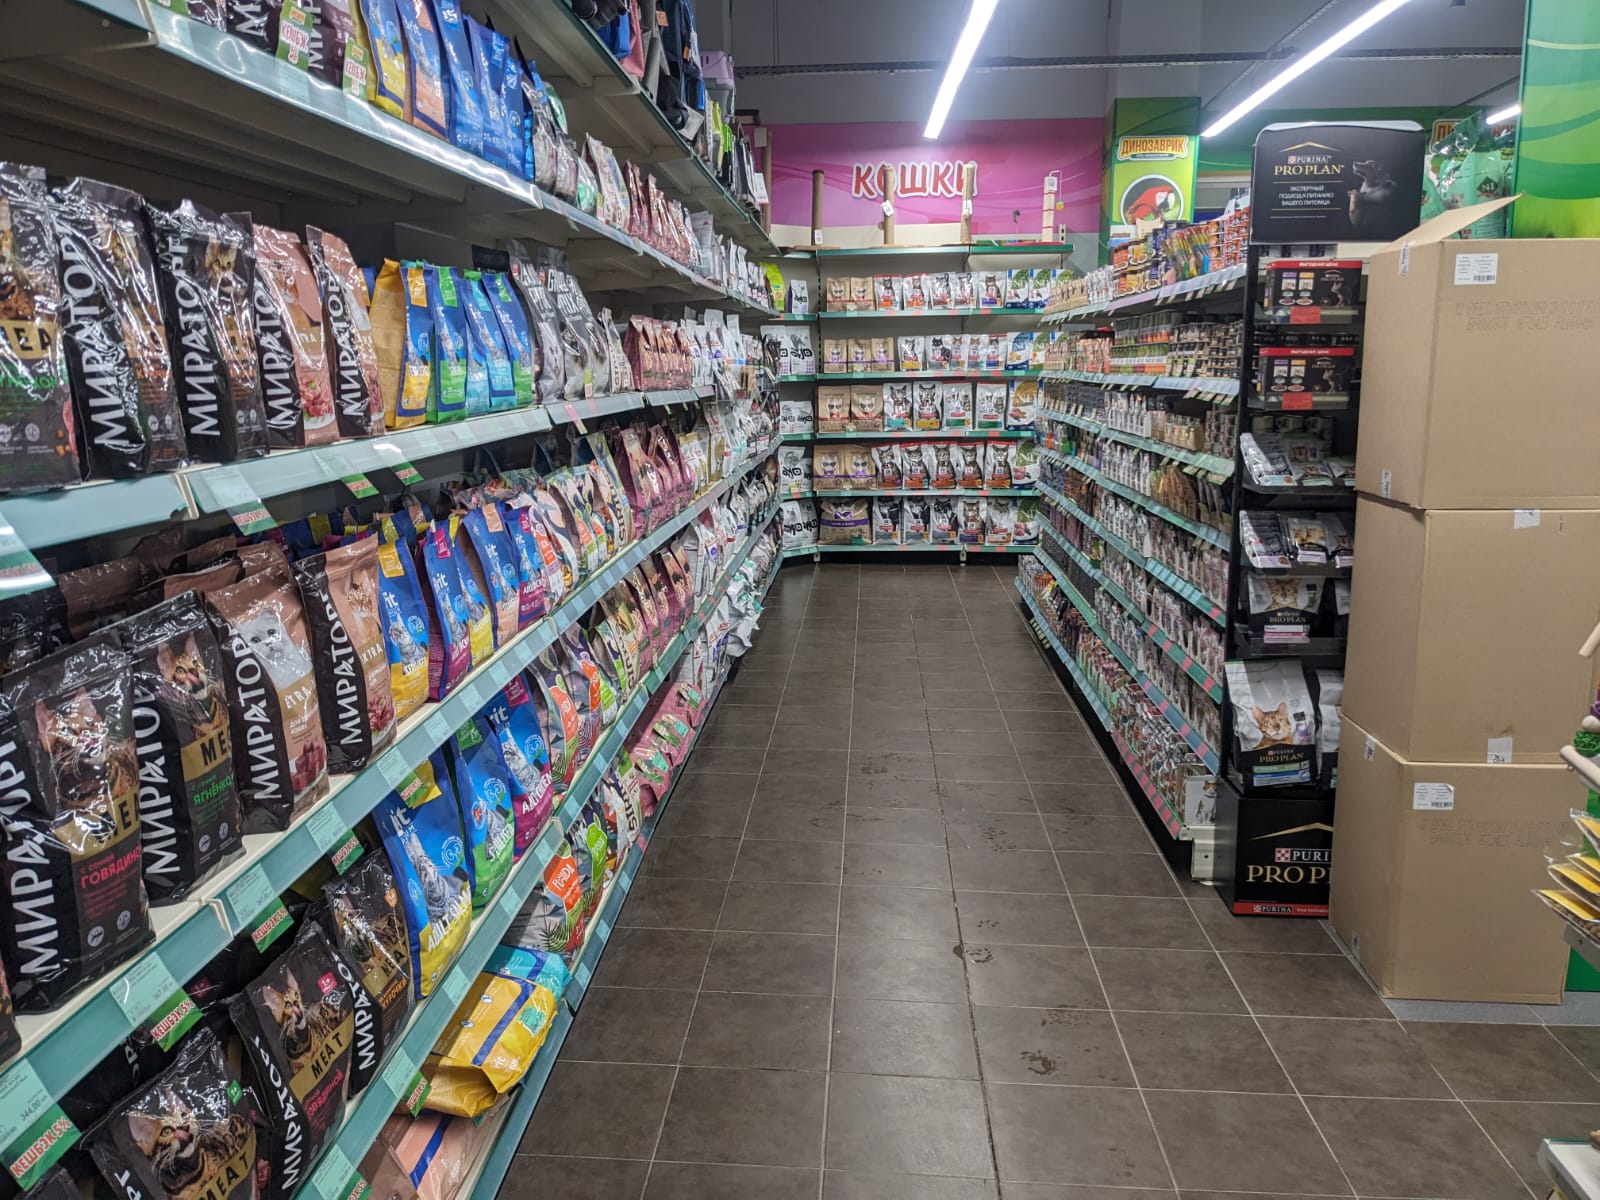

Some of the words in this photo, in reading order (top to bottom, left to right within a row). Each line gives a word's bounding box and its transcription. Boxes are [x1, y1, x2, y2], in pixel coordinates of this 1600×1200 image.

[1120, 138, 1186, 157] ДИНОЗАВРИК
[1274, 164, 1303, 176] PRO
[1305, 164, 1342, 176] PLAN
[200, 735, 232, 768] ME
[1246, 865, 1304, 884] PRO
[252, 914, 280, 942] КЕШБЭК
[151, 1008, 184, 1041] КЕШБЭК
[181, 999, 195, 1015] 5%
[310, 1031, 345, 1079] MEAT
[10, 1131, 59, 1178] КЕШБЭК
[53, 1116, 73, 1137] 5%
